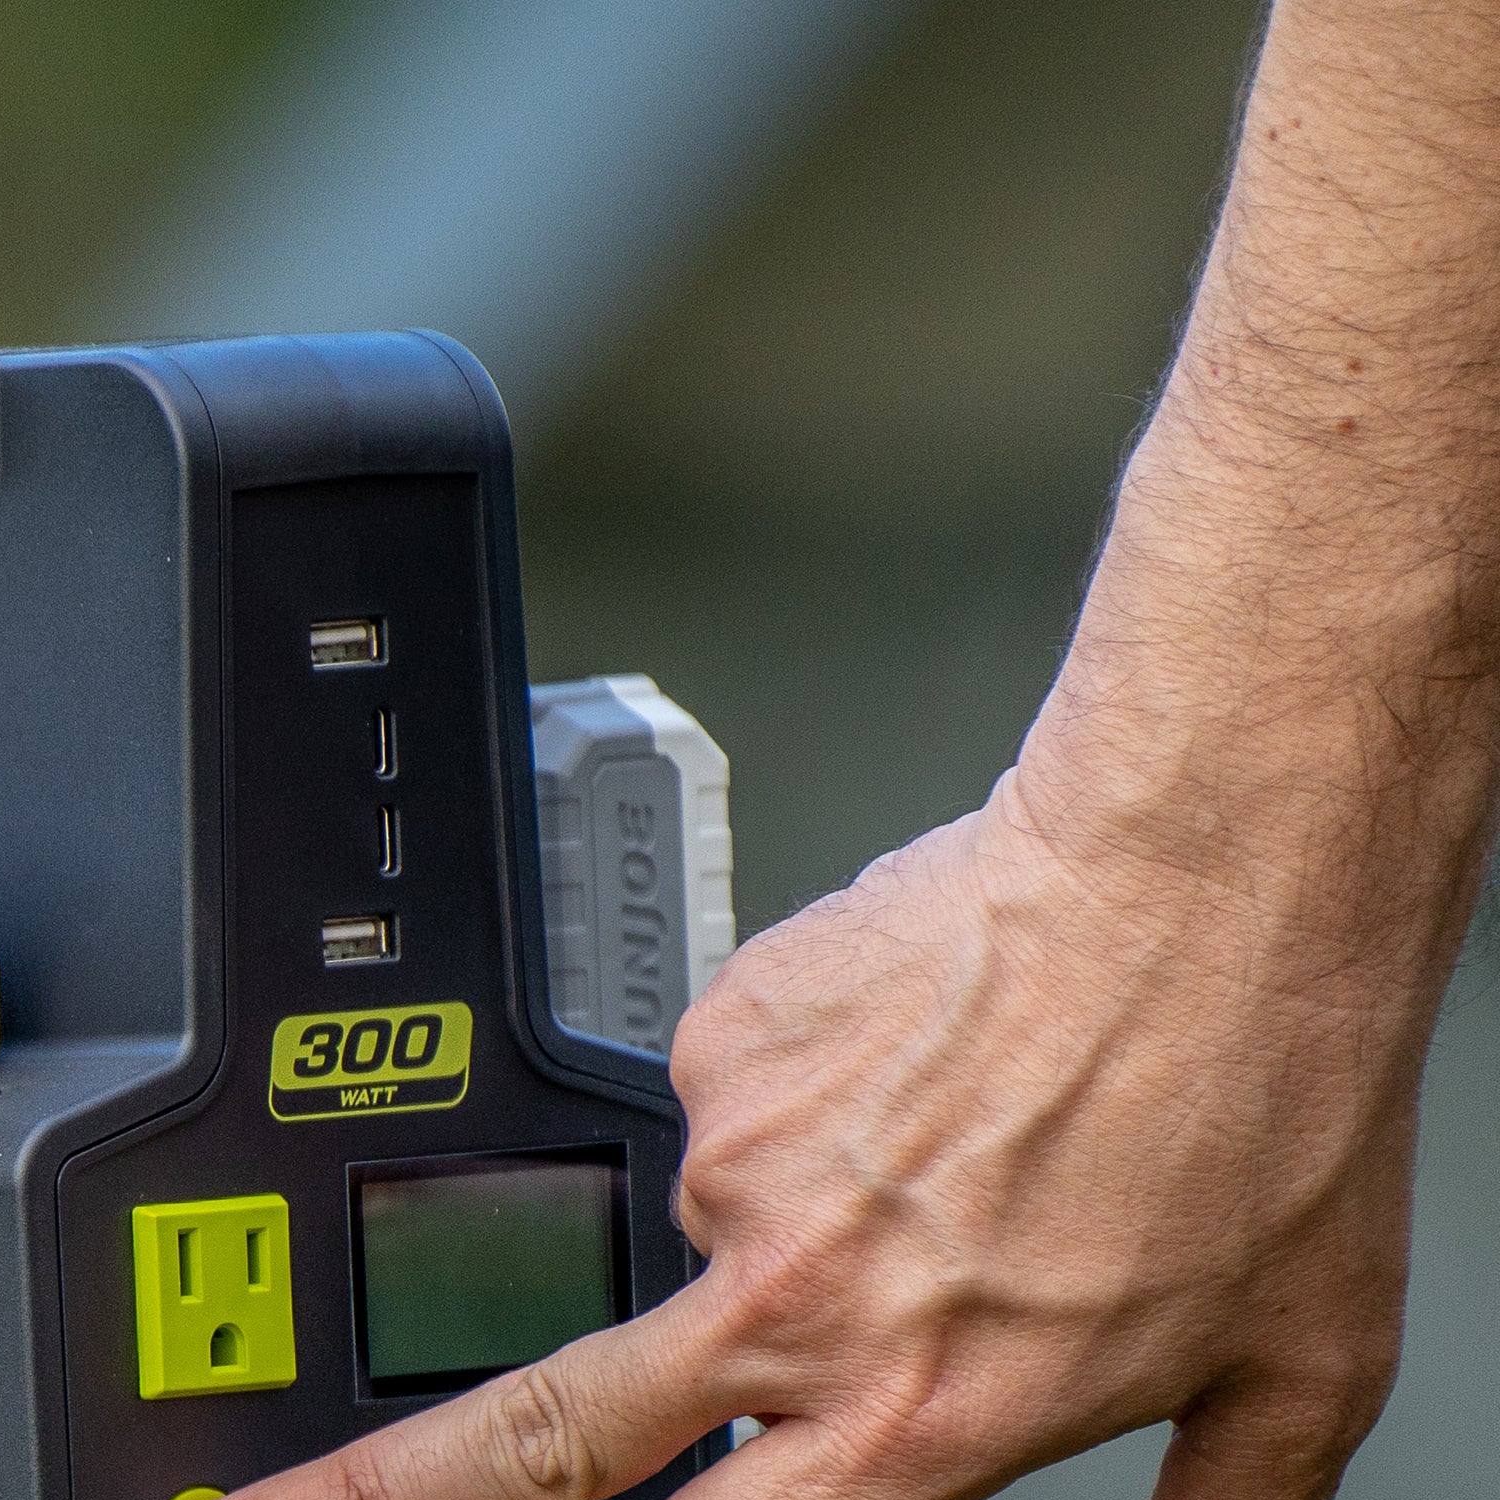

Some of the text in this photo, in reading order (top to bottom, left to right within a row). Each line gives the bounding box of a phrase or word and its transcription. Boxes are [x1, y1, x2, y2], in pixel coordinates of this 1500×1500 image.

[618, 800, 668, 1050] UNJOE
[294, 1013, 443, 1078] 300
[341, 1086, 399, 1107] WATT
